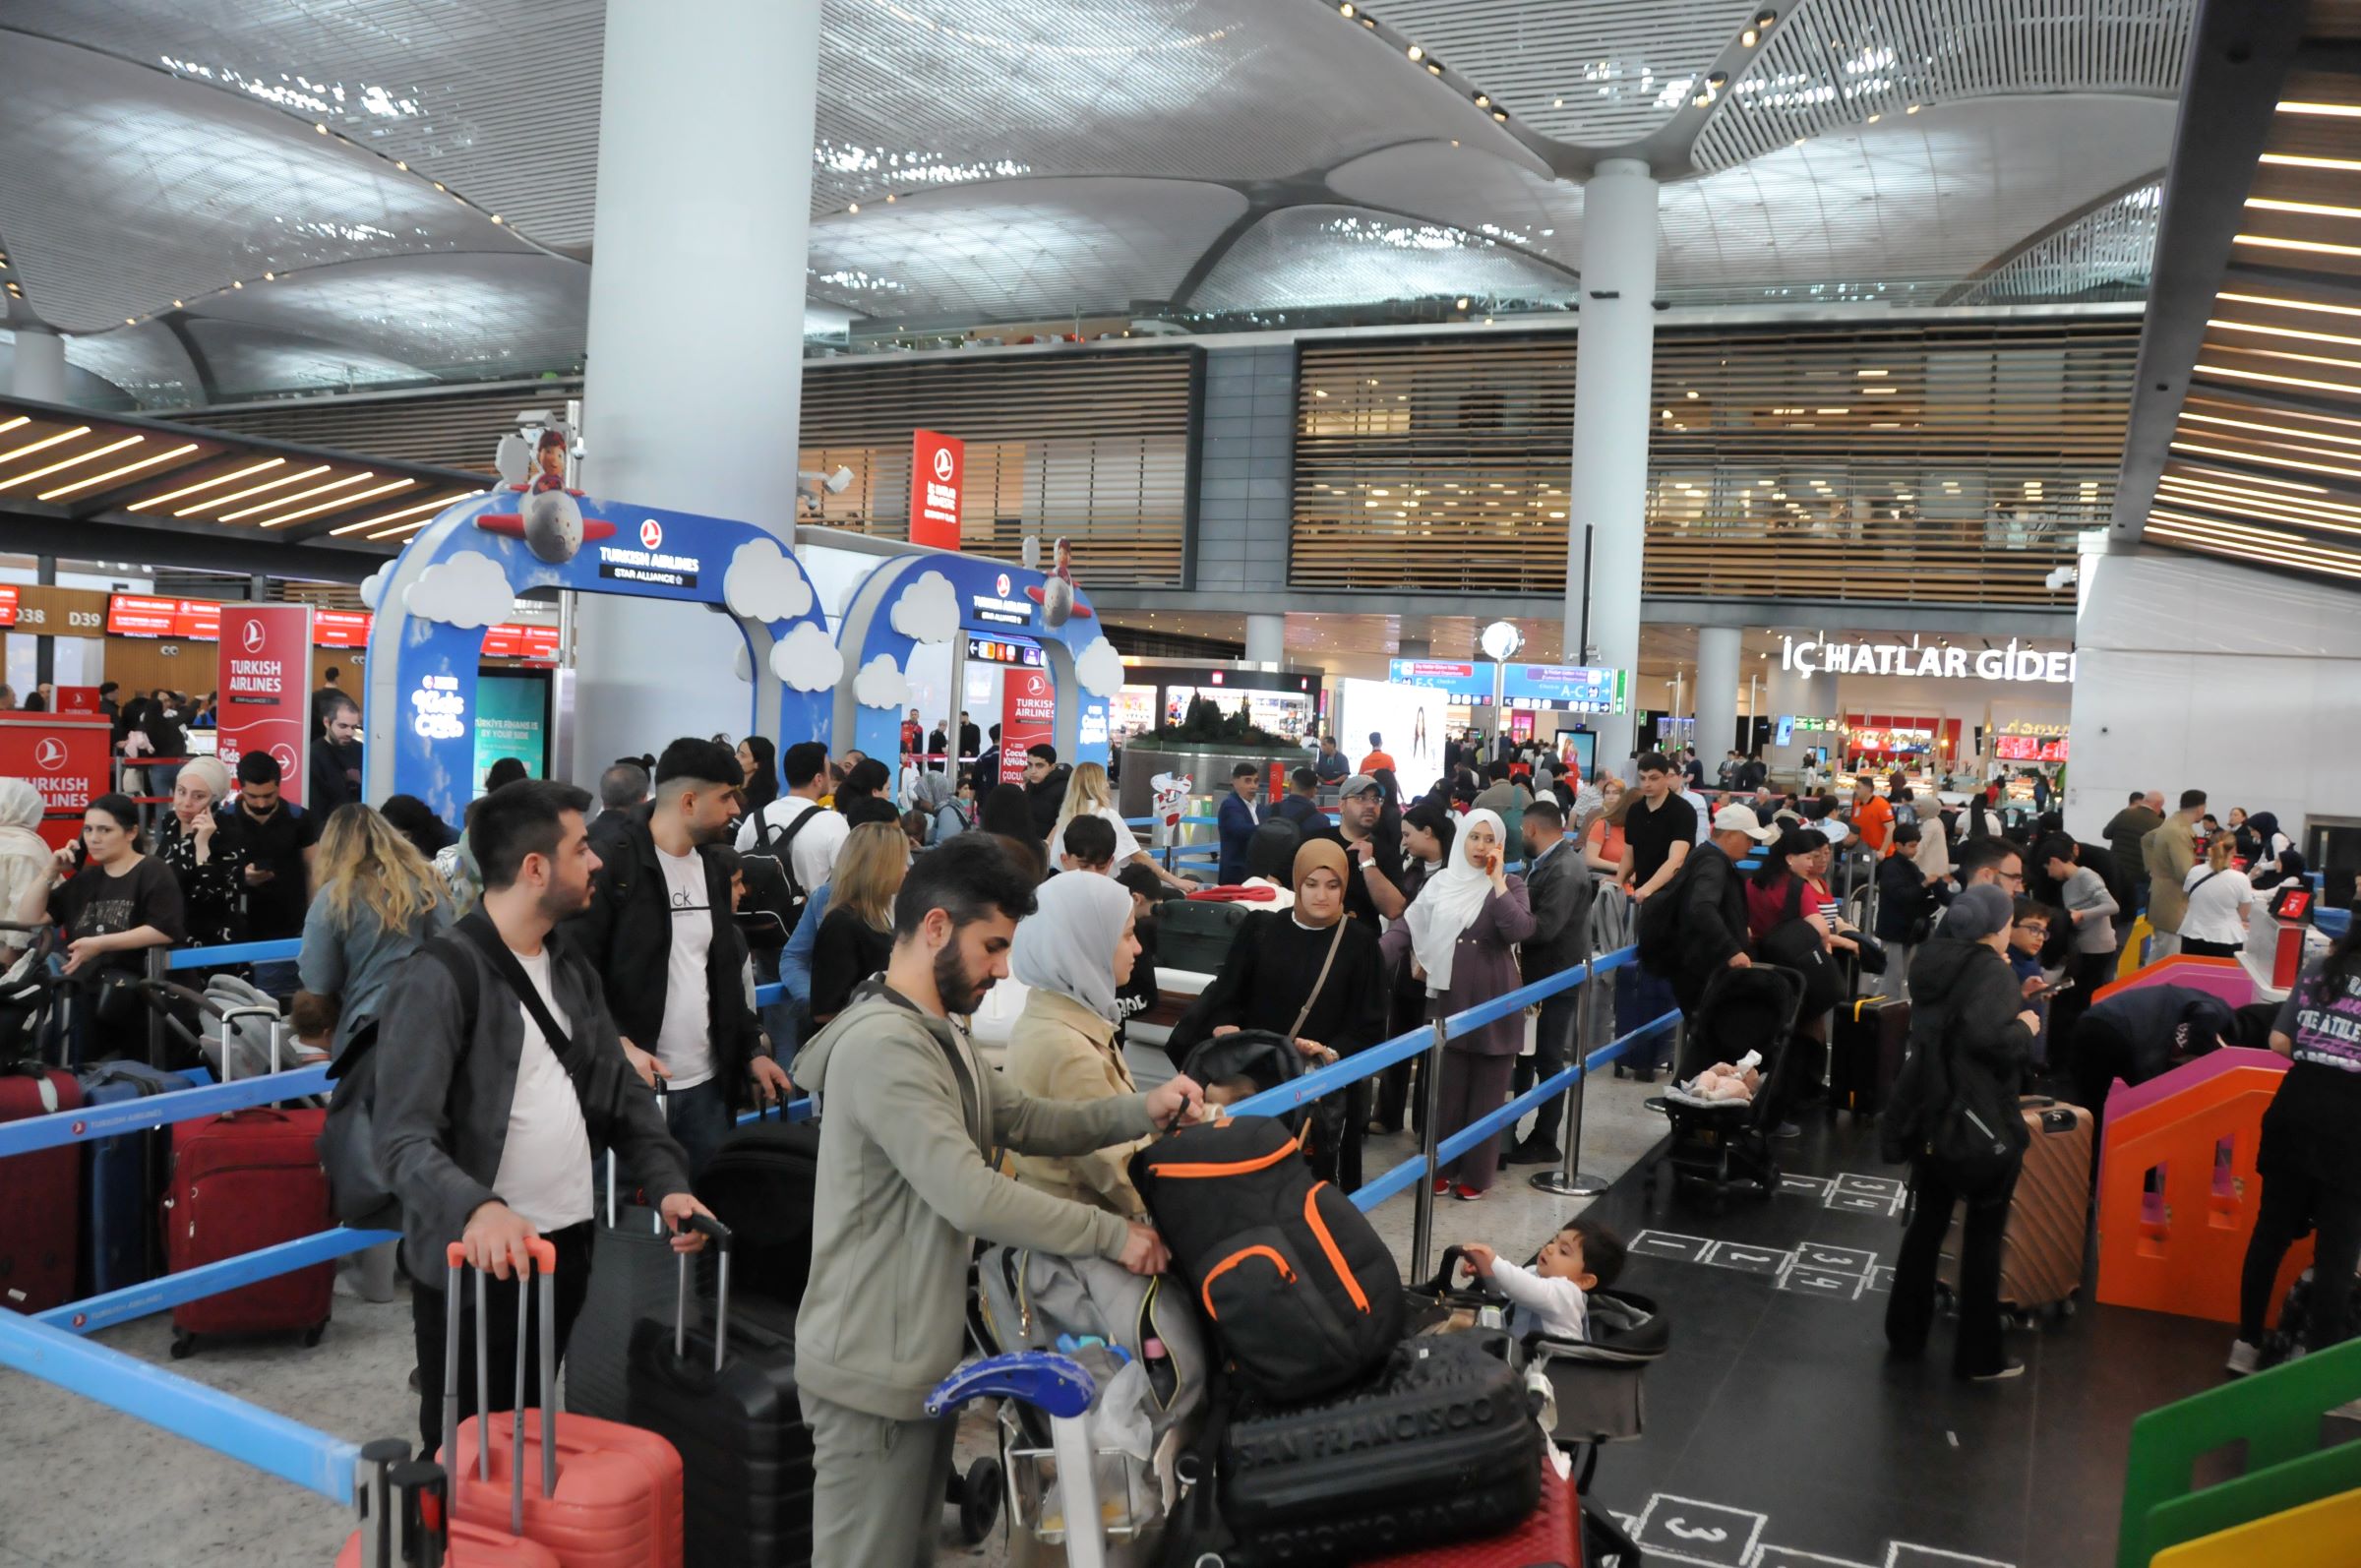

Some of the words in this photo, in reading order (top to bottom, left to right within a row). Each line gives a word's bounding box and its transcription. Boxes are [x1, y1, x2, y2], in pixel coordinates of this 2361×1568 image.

[599, 547, 649, 567] TURKISH
[650, 554, 699, 573] AIRLINES
[614, 568, 636, 578] STAR
[636, 571, 676, 584] ALLIANCE
[16, 608, 45, 624] D38
[69, 612, 101, 627] D39
[1783, 635, 1818, 679] İÇ
[1825, 643, 1967, 678] HATLAR
[230, 659, 281, 676] TURKISH
[229, 676, 281, 693] AIRLINES
[1560, 685, 1585, 698] A-C
[25, 777, 89, 791] URKISH
[41, 793, 89, 807] LINES
[672, 884, 693, 906] ck
[1812, 1252, 1853, 1265] 3
[1801, 1277, 1843, 1290] 4
[1665, 1517, 1727, 1542] 3
